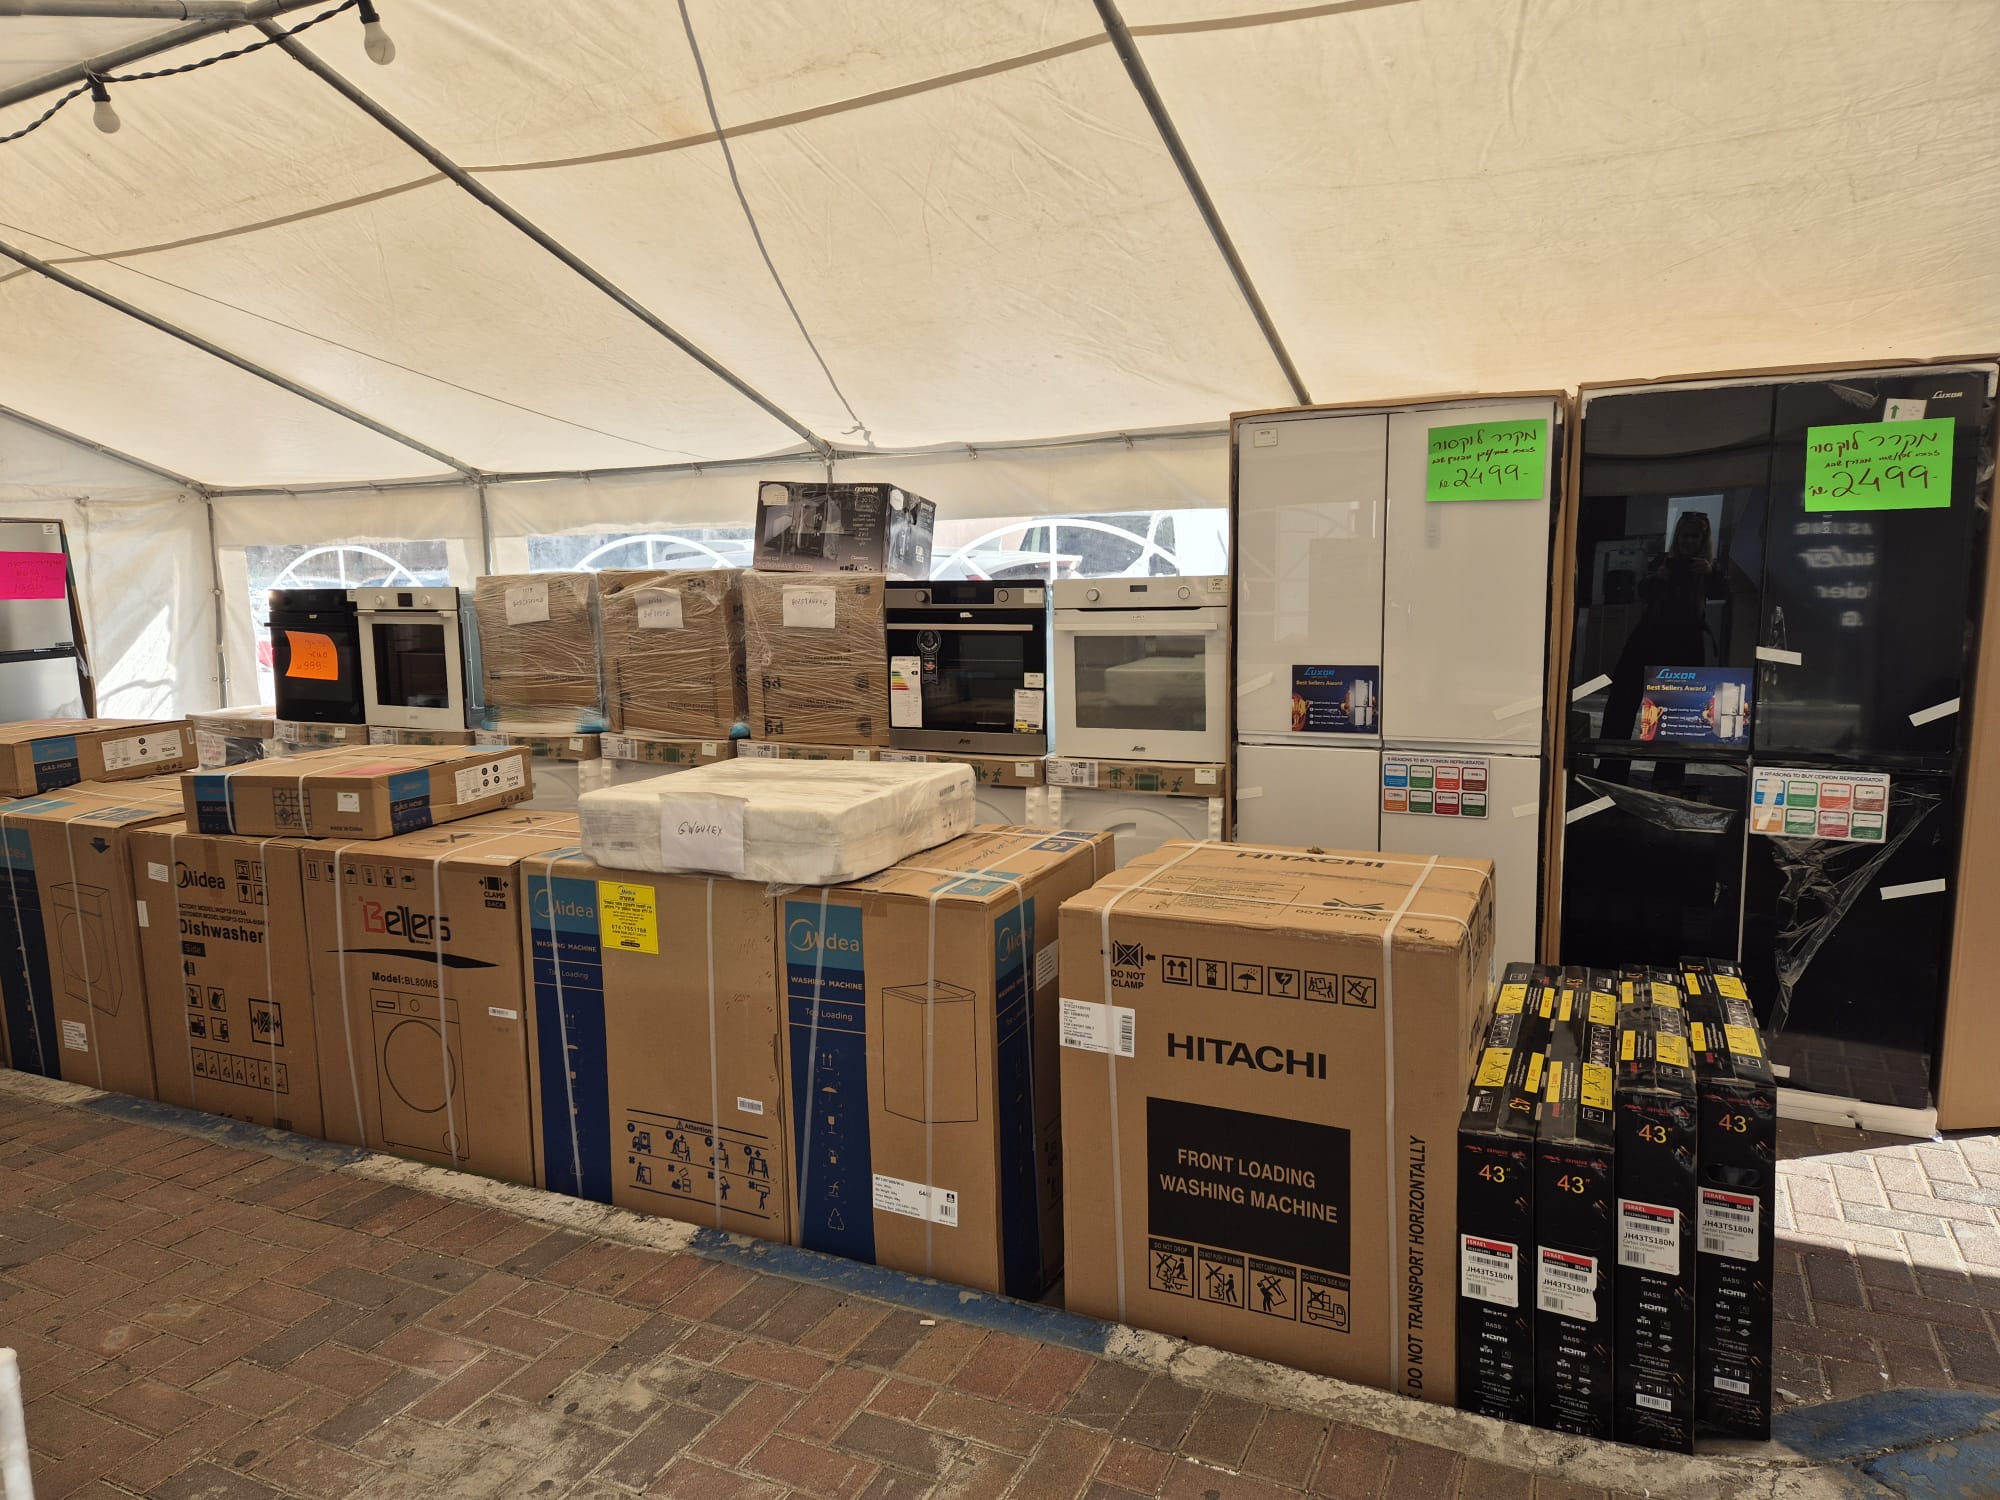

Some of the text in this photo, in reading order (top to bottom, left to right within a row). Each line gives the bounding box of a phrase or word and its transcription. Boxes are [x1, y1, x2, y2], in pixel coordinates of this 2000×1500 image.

[1432, 428, 1537, 453] מקרר לוקסור
[1810, 430, 1938, 457] מקרר לוקסור
[854, 485, 879, 494] gorenje
[1236, 852, 1385, 869] HITACHI
[175, 861, 226, 889] Midea
[484, 891, 506, 899] CLAMP
[534, 888, 594, 919] Midea
[358, 896, 452, 944] Bellers
[1342, 913, 1375, 922] STEP
[180, 919, 264, 943] Dishwasher
[789, 918, 859, 952] Mdea
[537, 940, 597, 953] WASHNG MACHINE
[561, 969, 589, 981] Loading
[1111, 969, 1146, 981] DO NOT
[791, 976, 863, 991] WASHIG MACHINE
[1112, 979, 1144, 990] CLAMP
[821, 1010, 853, 1022] Loading
[1167, 1032, 1327, 1080] HITACHI
[685, 1122, 712, 1135] Attention
[1178, 1148, 1315, 1190] FRONT LOADING
[1160, 1174, 1338, 1224] WASHING MACHINE
[1704, 1191, 1726, 1201] ISRAEL
[1624, 1203, 1646, 1212] ISRAEL
[1736, 1203, 1753, 1211] Black
[1656, 1215, 1672, 1223] Black
[1163, 1243, 1173, 1251] NOT
[1173, 1245, 1188, 1253] DROP
[1467, 1239, 1487, 1248] ISRAEL
[1496, 1250, 1511, 1258] Black
[1544, 1251, 1565, 1261] ISRAEL
[1264, 1264, 1278, 1273] CARRY
[1408, 1136, 1426, 1390] DO NOT TRANSPORT HORIZONTALLY
[1574, 1263, 1590, 1272] Black
[1718, 1287, 1747, 1298] HDMI
[1639, 1302, 1667, 1313] HDMI
[1482, 1332, 1508, 1344] HDMI
[1559, 1346, 1586, 1358] HDMI
